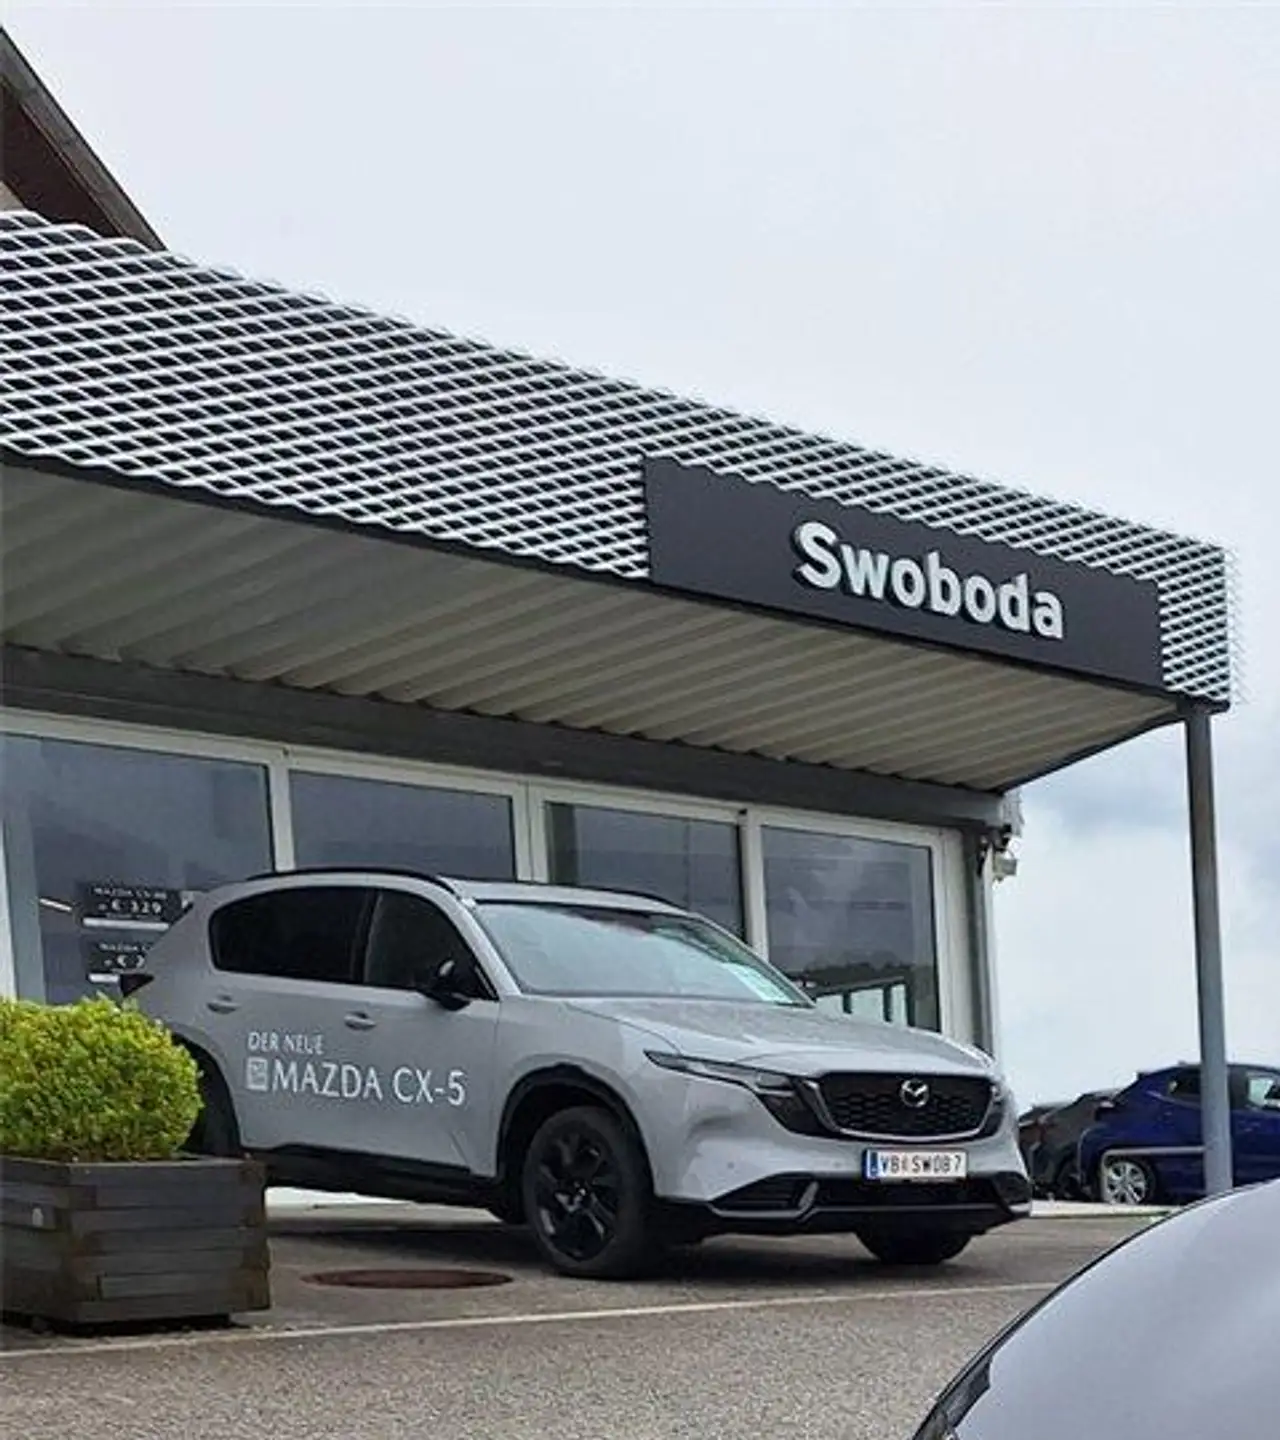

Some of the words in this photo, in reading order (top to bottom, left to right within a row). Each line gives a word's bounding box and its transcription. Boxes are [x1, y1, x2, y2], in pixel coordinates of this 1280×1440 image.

[793, 521, 1066, 640] Swoboda
[248, 1031, 279, 1051] DER
[283, 1034, 325, 1056] NEUE
[272, 1059, 383, 1100] MAZDA
[392, 1066, 466, 1106] CX-5
